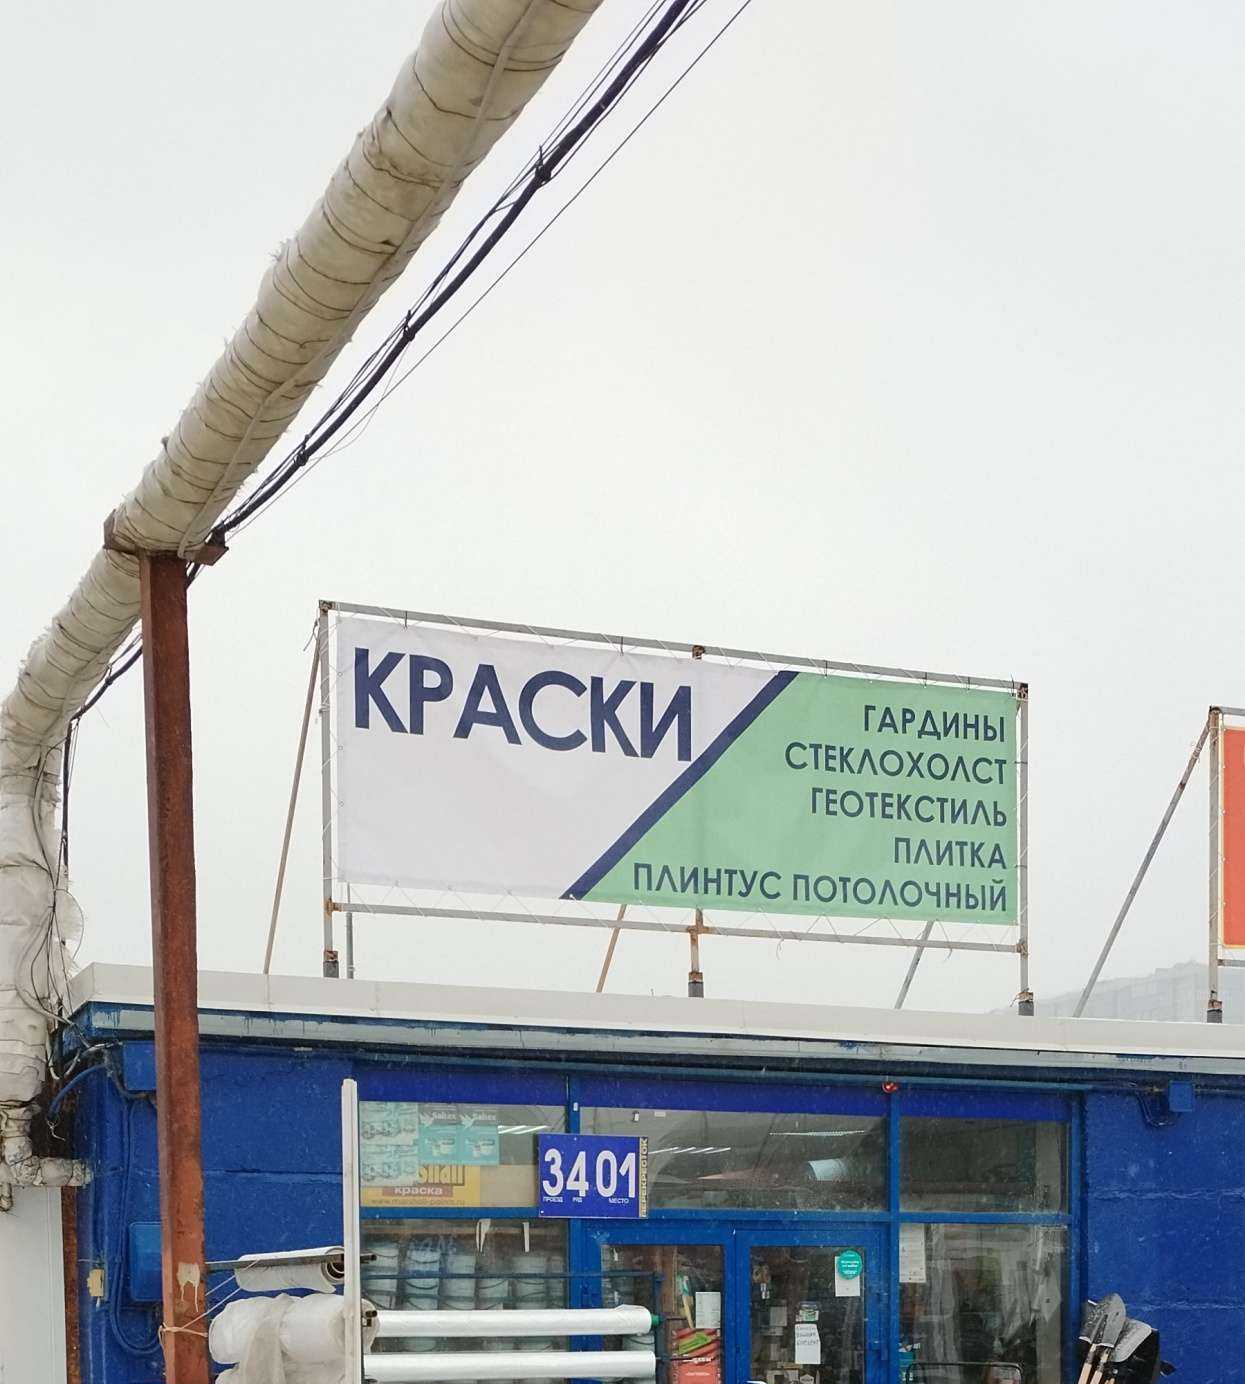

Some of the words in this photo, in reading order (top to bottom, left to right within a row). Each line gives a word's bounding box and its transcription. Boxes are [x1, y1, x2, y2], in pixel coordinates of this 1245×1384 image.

[354, 647, 692, 762] КРАСКИ
[864, 704, 1005, 743] ГАРДИНЫ
[784, 741, 1007, 785] СТЕКЛОХОЛСТ
[811, 787, 1007, 827] ГЕОТЕКСТИЛЬ
[894, 837, 1007, 870] ПЛИТКА
[634, 862, 782, 900] ПЛИНТУС
[793, 874, 1006, 912] ПОТОЛОЧНЫЙ
[394, 1186, 443, 1197] краска
